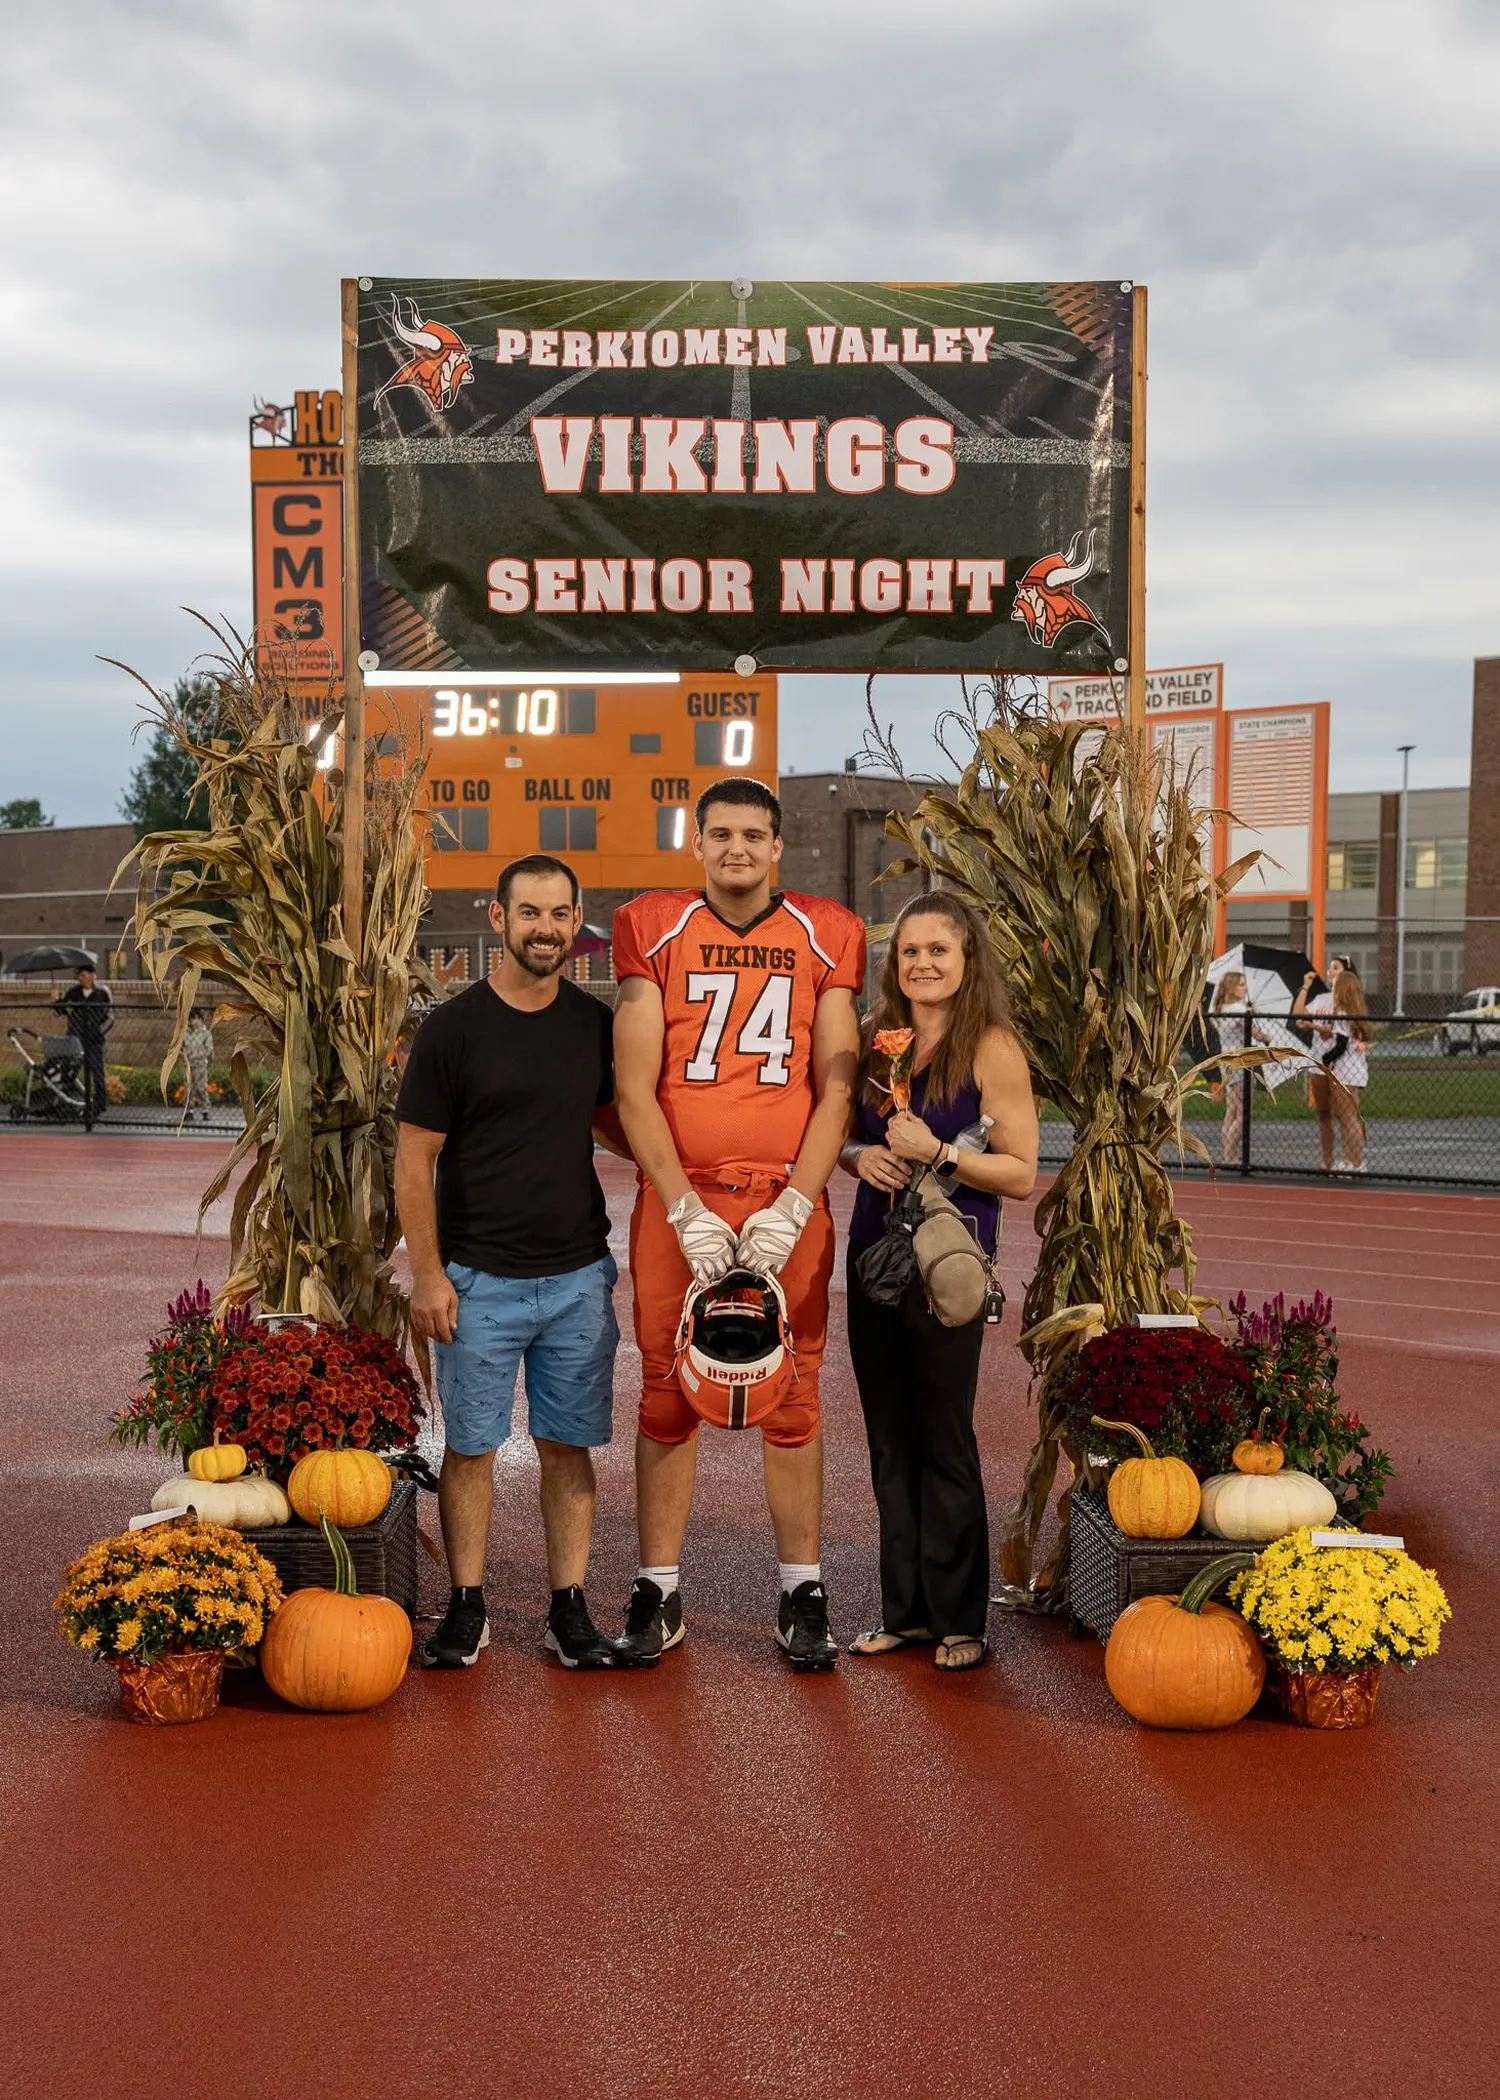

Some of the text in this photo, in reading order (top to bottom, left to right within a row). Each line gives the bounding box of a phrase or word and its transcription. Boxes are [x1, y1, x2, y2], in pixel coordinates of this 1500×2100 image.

[496, 325, 996, 369] PERKIOMEN VALLEY
[297, 452, 344, 476] TH
[530, 416, 957, 495] VIKINGS
[486, 558, 1006, 614] SENIOR NIGHT
[1158, 672, 1214, 690] VALLEY
[687, 692, 760, 718] GUEST
[1145, 694, 1162, 709] ND
[1167, 689, 1213, 708] FIELD
[431, 690, 557, 737] 36:10
[723, 720, 753, 767] 0
[430, 779, 490, 802] TO GO
[524, 778, 611, 802] BALL ON
[651, 778, 690, 801] QTR
[699, 944, 796, 970] VIKINGS
[684, 971, 795, 1087] 74
[707, 1366, 767, 1383] Riddell
